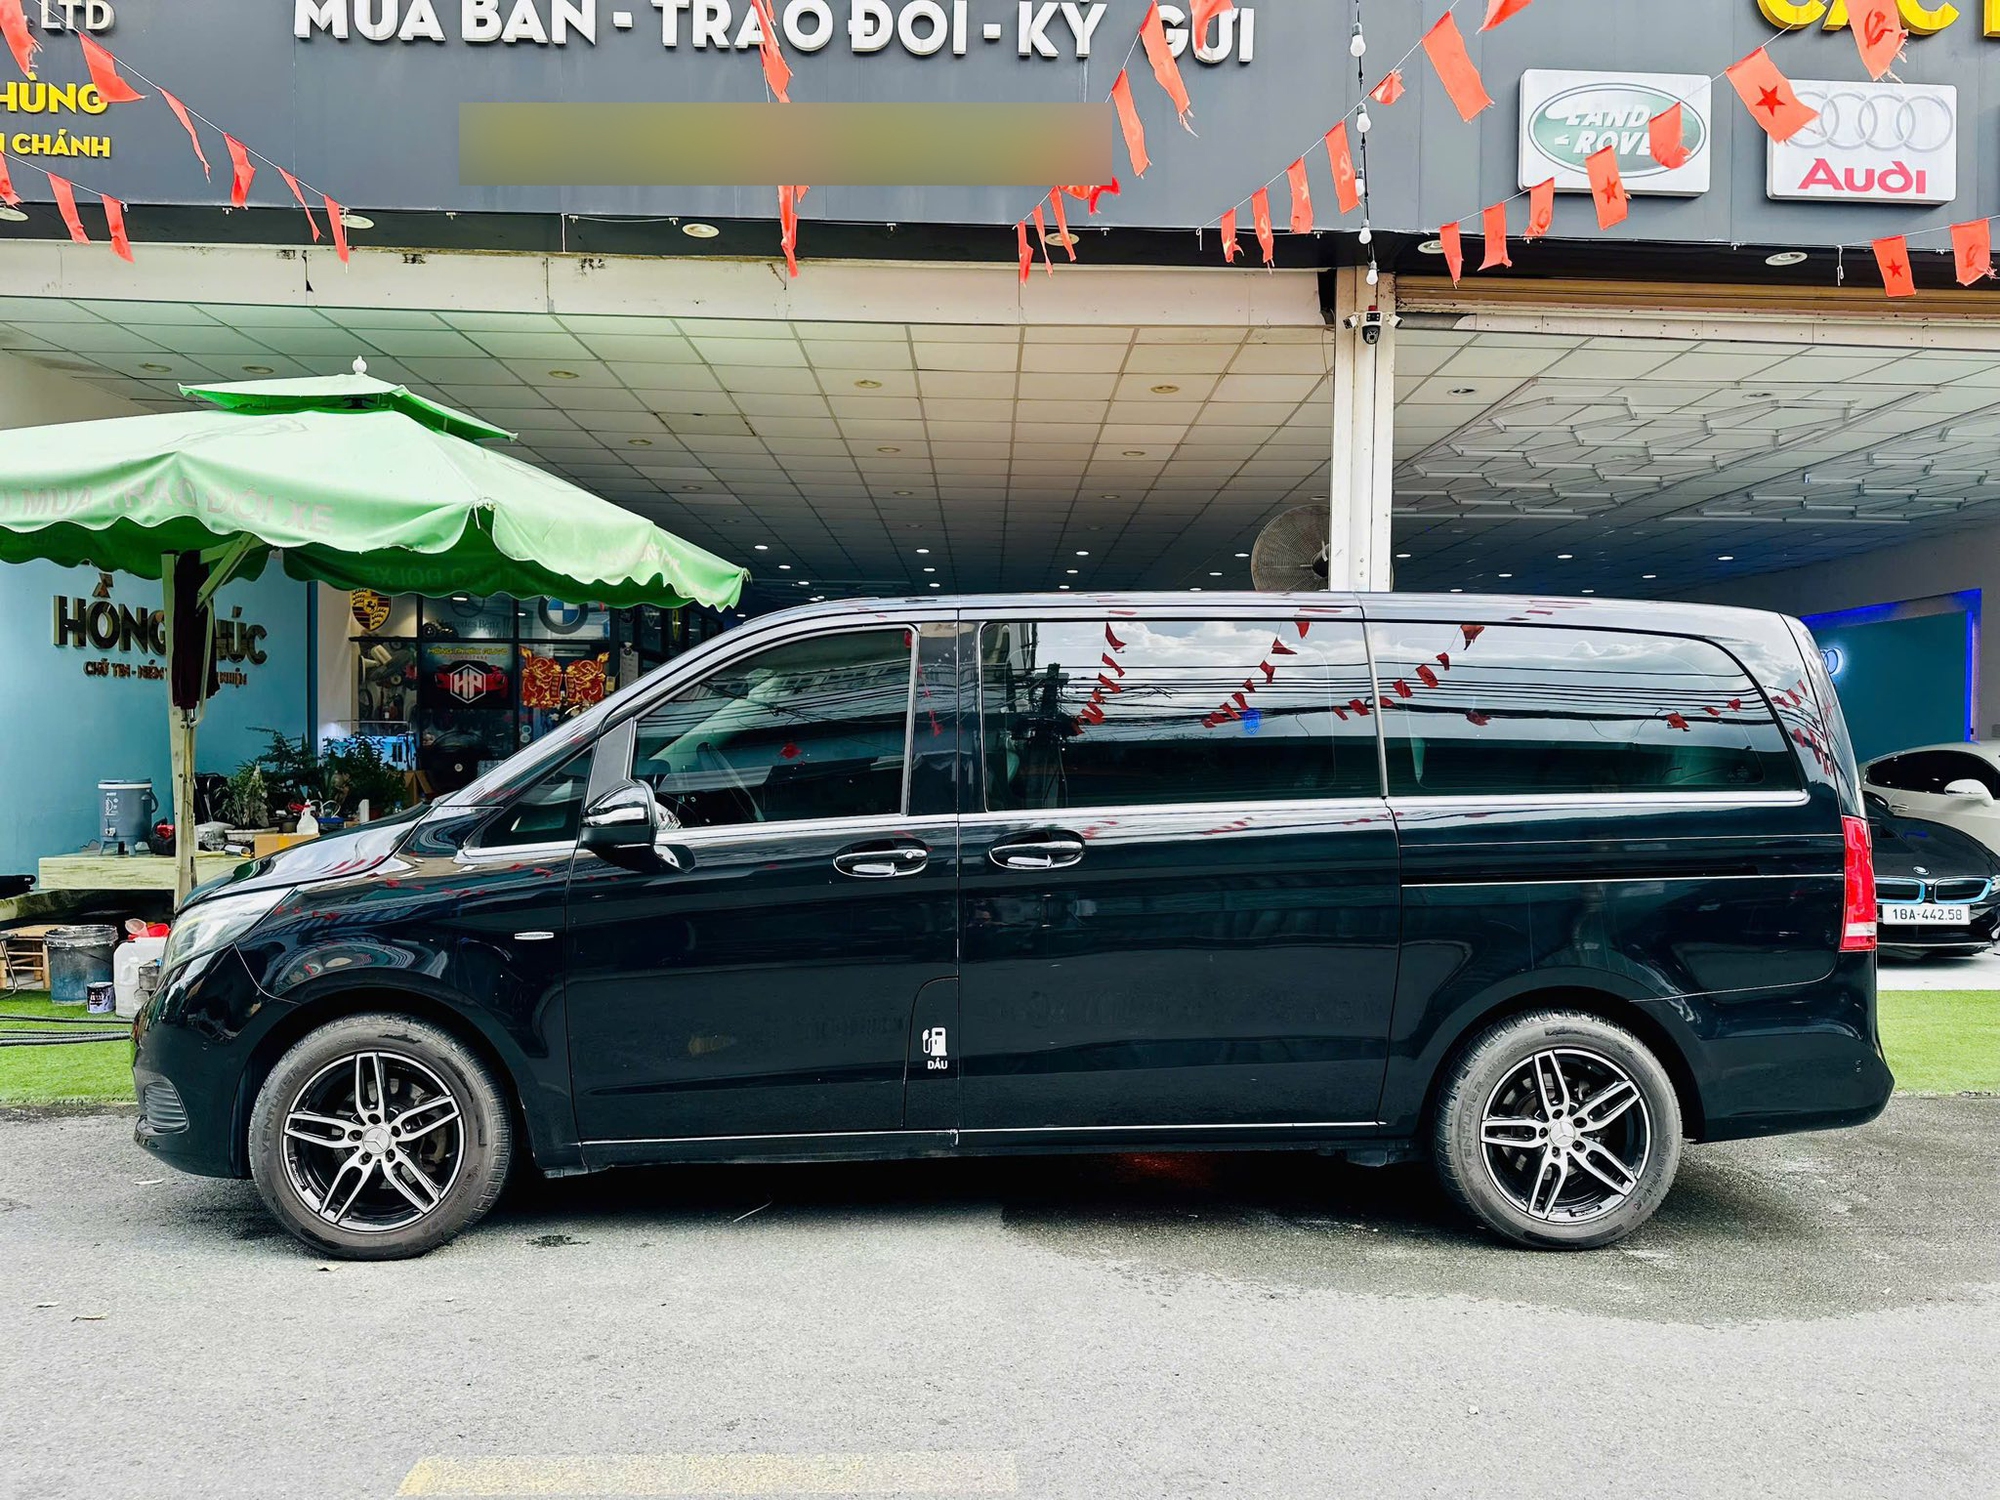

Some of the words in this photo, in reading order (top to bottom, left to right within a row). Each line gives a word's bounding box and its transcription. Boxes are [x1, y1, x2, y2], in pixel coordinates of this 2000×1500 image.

[41, 0, 115, 30] LTD
[294, 0, 445, 42] MUA
[652, 0, 833, 52] TRAO
[11, 128, 111, 158] CHÁNH
[1797, 158, 1926, 194] Audi
[1892, 908, 1963, 921] 18A-442.58
